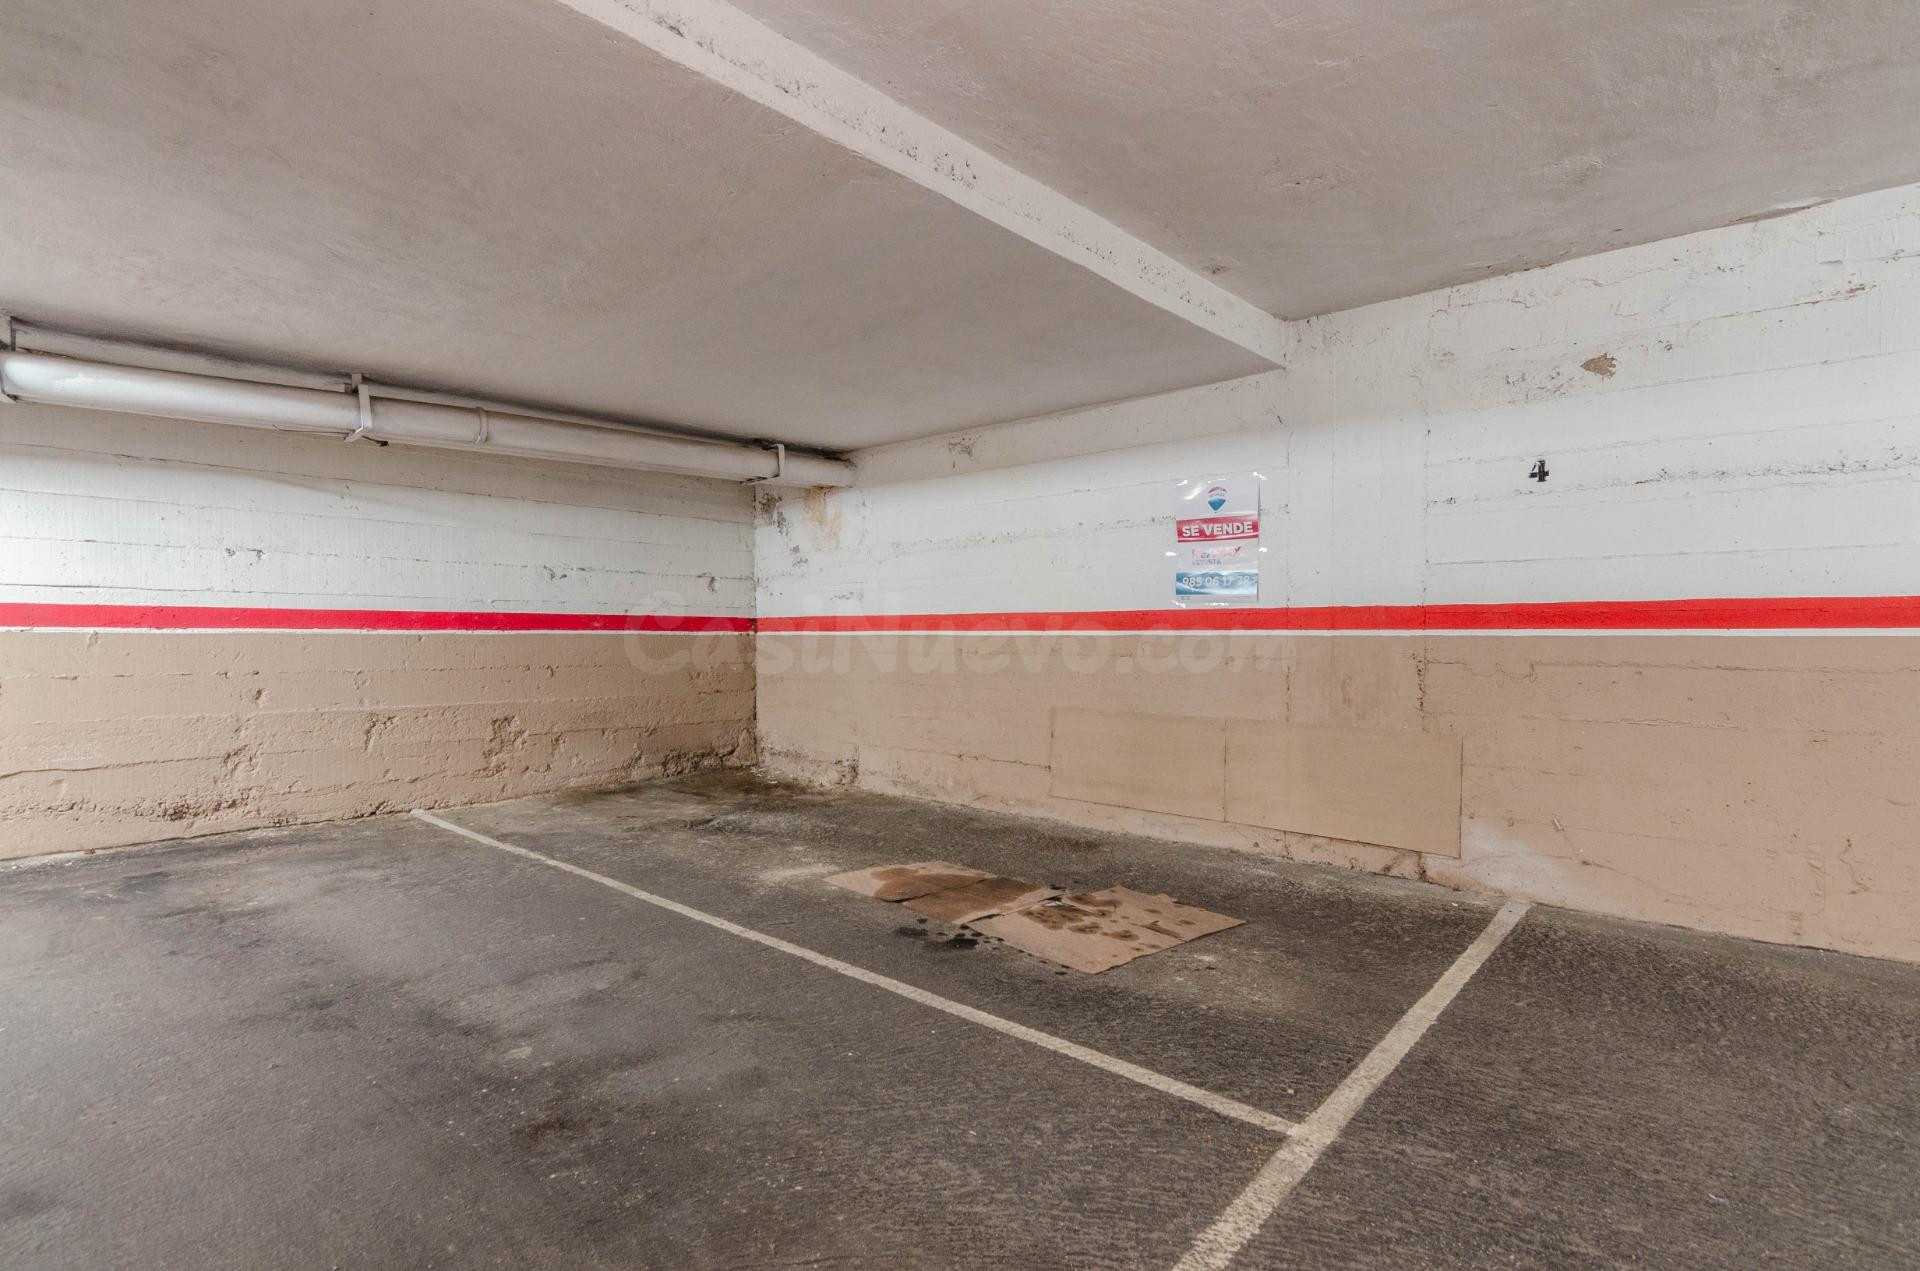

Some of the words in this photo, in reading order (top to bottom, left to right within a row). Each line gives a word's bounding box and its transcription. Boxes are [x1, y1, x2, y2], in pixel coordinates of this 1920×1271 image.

[1528, 459, 1550, 483] 4
[1182, 525, 1200, 537] SE
[1202, 521, 1253, 536] VENDE
[1182, 576, 1203, 587] 985
